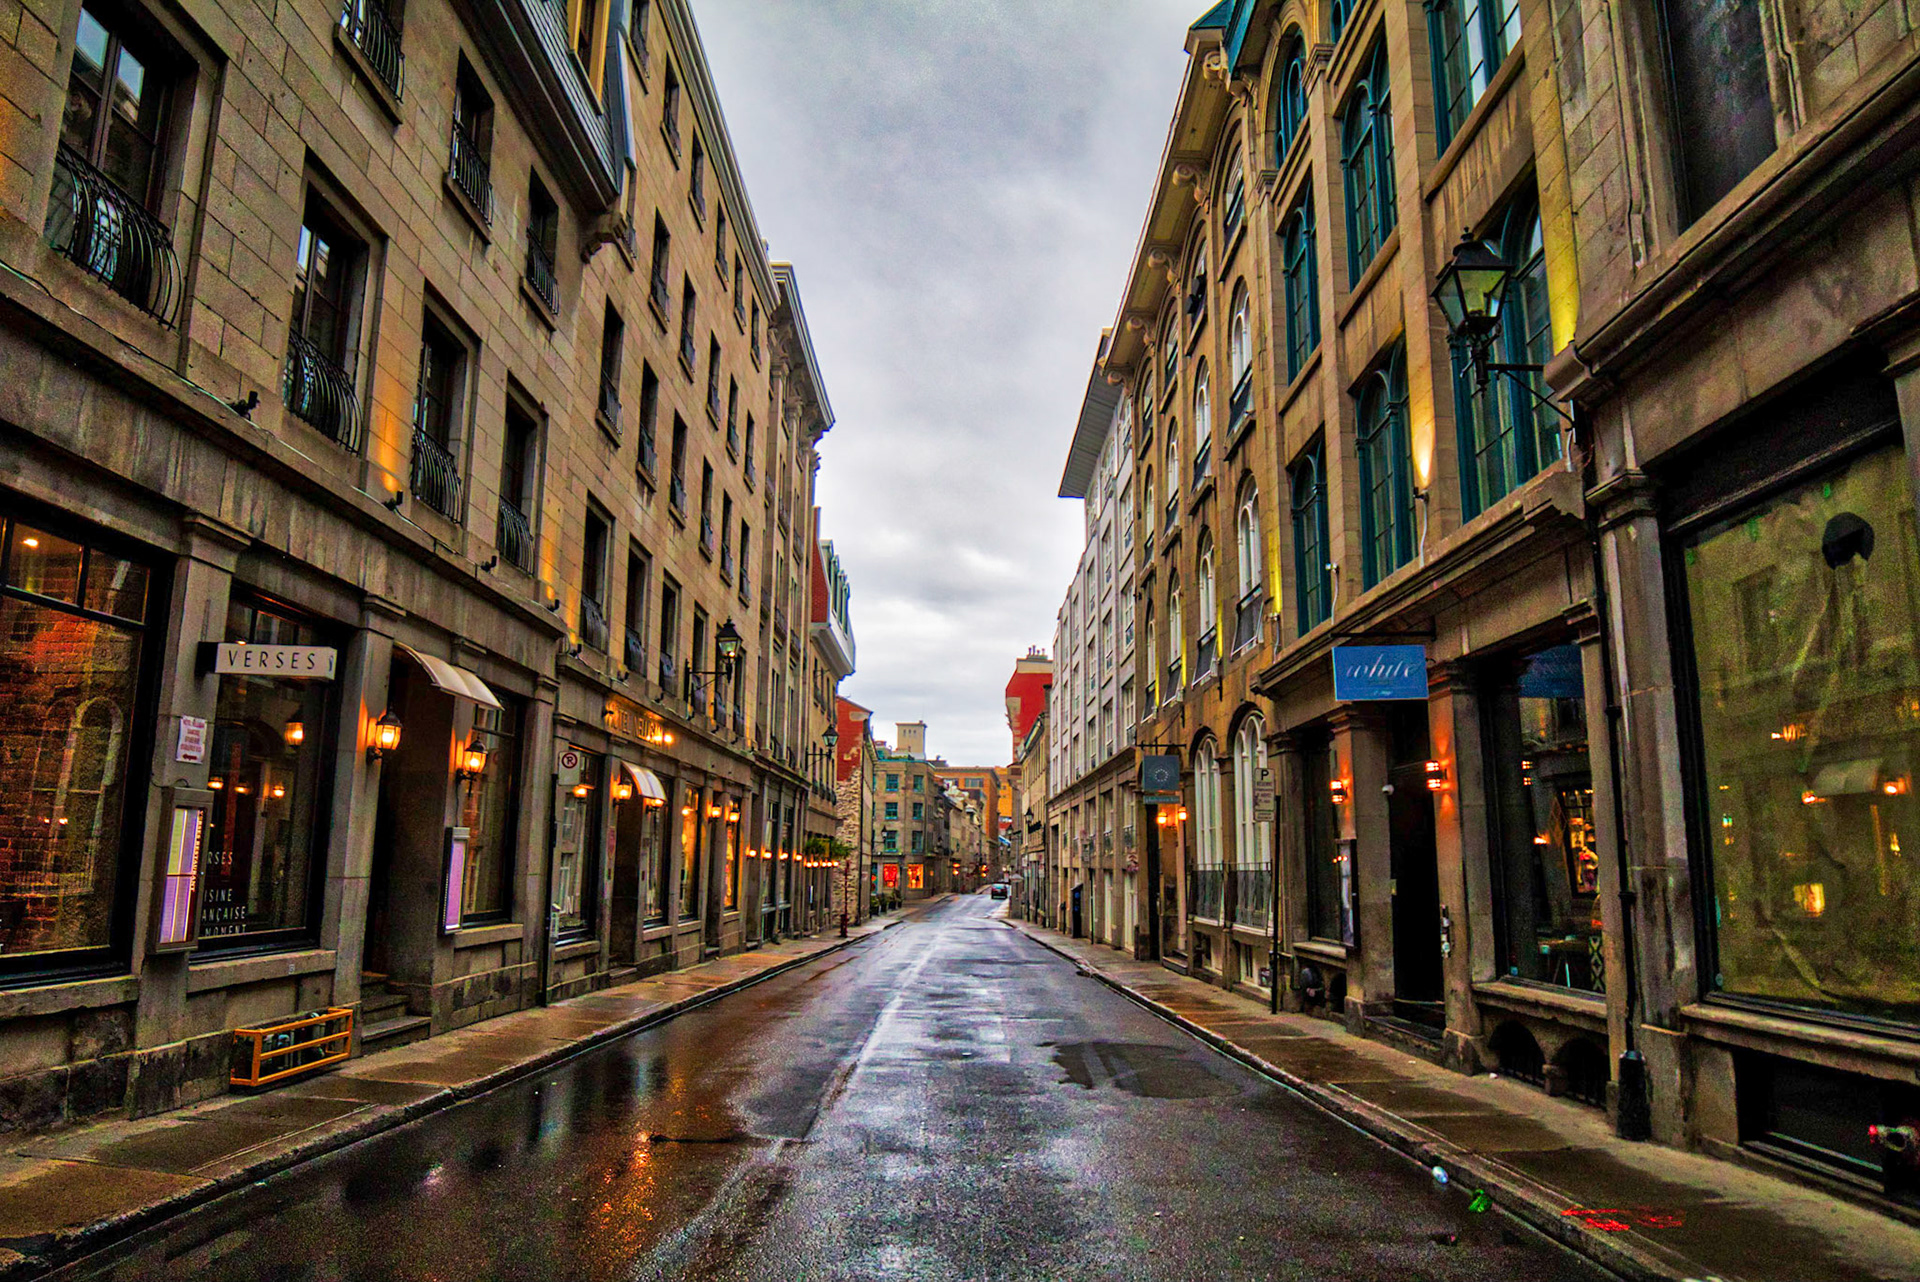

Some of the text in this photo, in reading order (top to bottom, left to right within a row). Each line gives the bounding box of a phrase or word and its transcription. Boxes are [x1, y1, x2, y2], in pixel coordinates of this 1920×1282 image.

[228, 649, 316, 670] VERSES
[1261, 769, 1269, 780] P
[208, 851, 233, 865] RSES
[204, 889, 233, 902] ISINE
[202, 906, 246, 922] ANÇAISE
